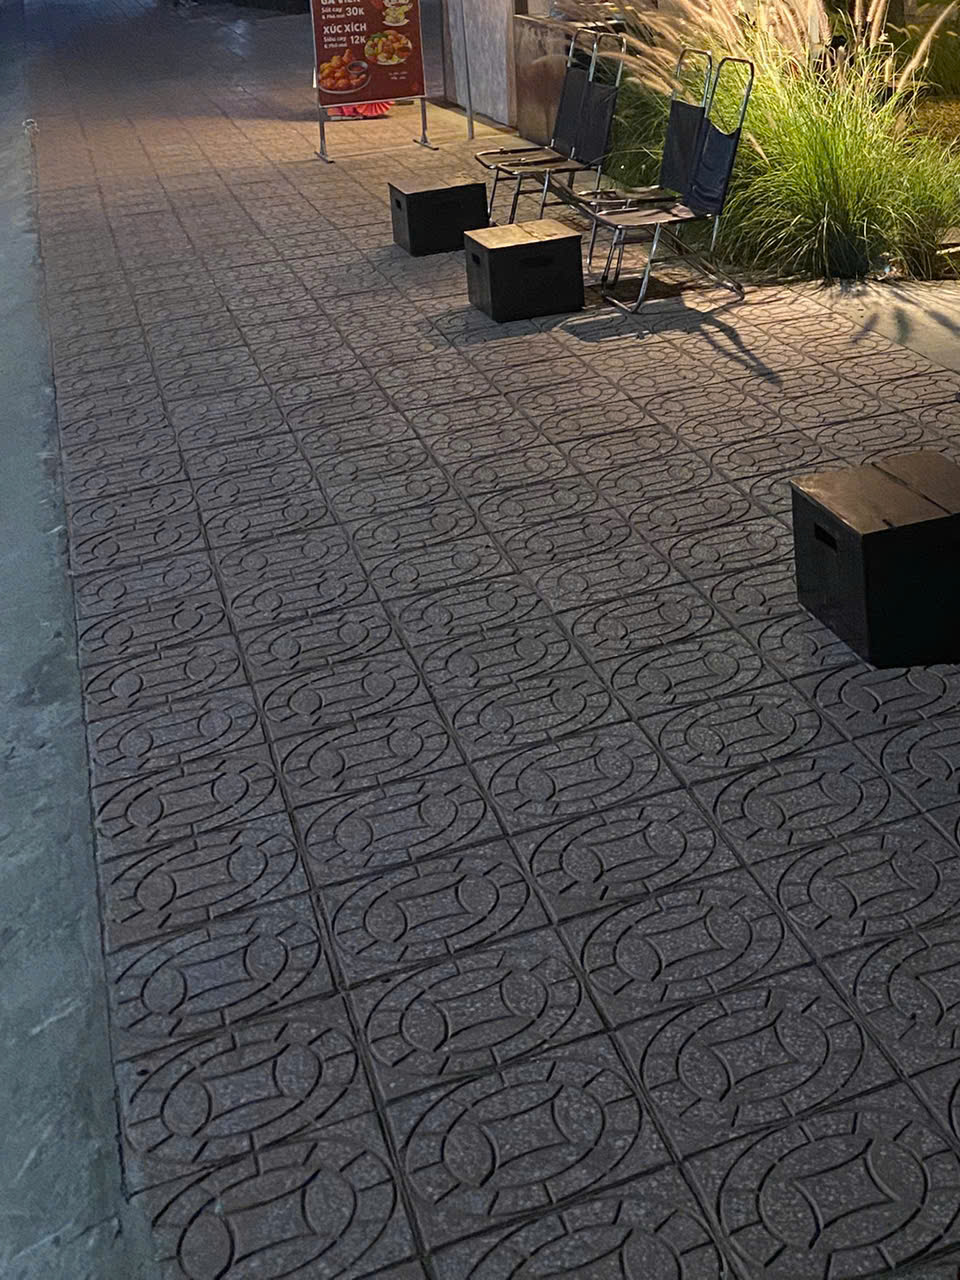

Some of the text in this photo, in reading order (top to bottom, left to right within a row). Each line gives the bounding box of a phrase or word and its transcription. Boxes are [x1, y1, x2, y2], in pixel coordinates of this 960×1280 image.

[345, 6, 365, 17] 30K
[323, 22, 367, 35] XÚC XÍCH
[350, 35, 367, 45] 12K
